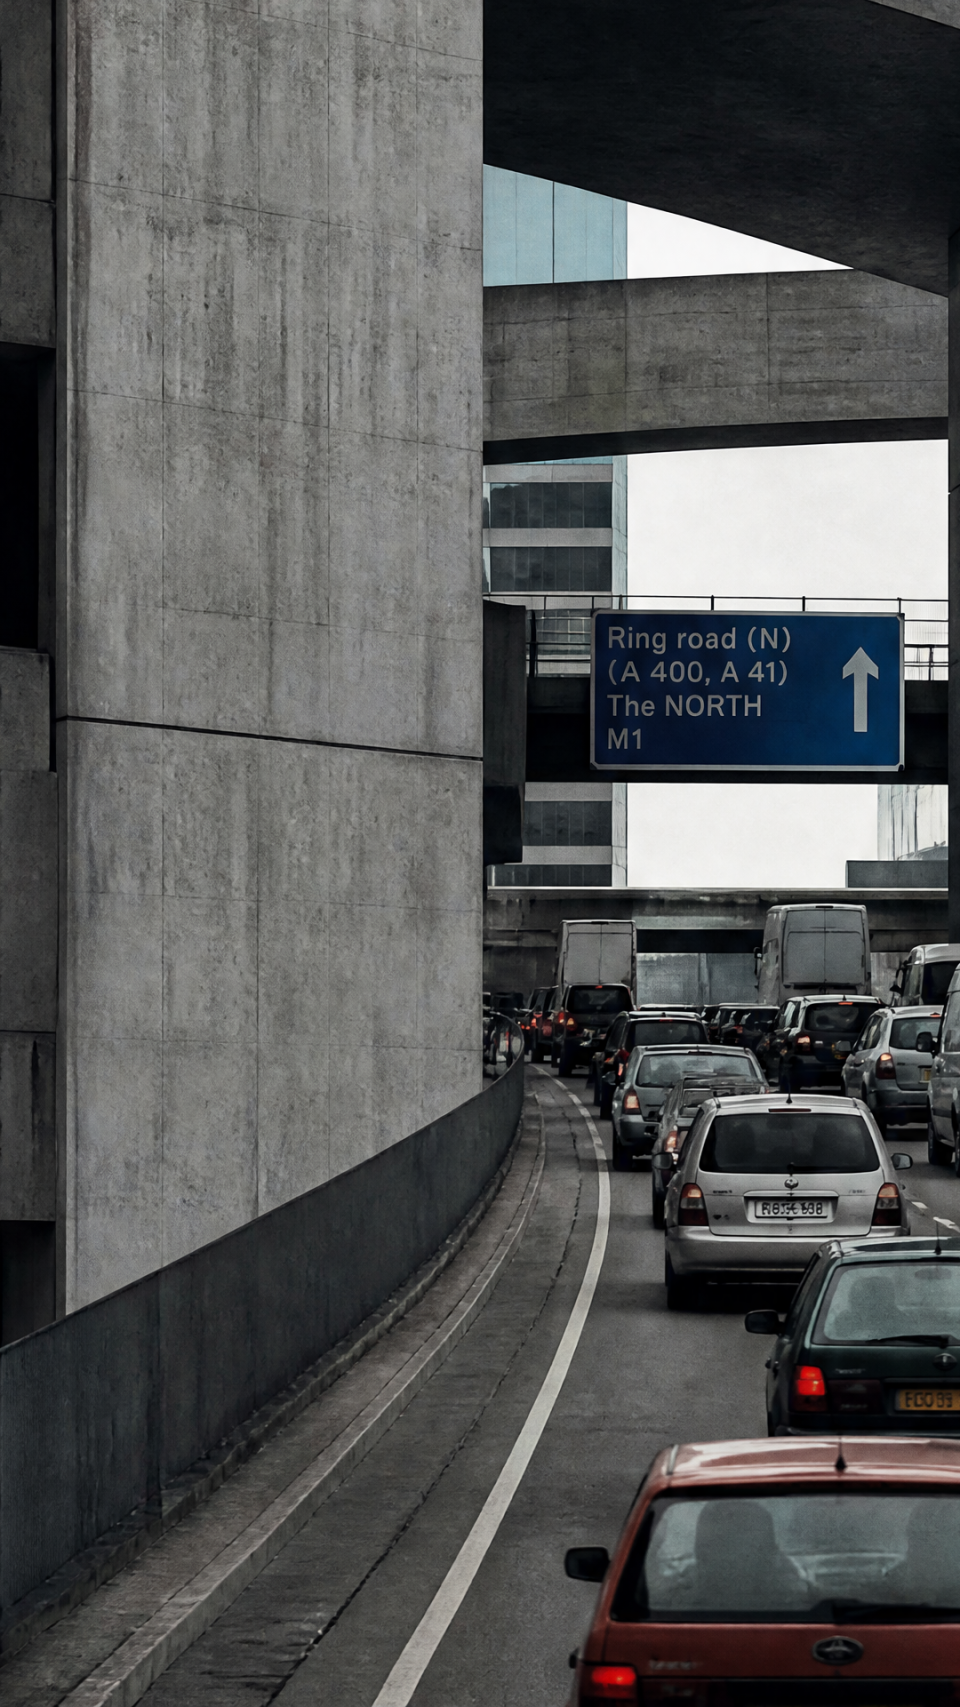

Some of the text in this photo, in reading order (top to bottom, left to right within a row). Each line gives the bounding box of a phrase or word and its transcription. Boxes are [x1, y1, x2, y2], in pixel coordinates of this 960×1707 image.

[608, 626, 791, 654] Ring road (N)
[608, 659, 788, 686] (A 400, A 41)
[606, 694, 763, 717] The NORTH
[607, 728, 642, 750] M1
